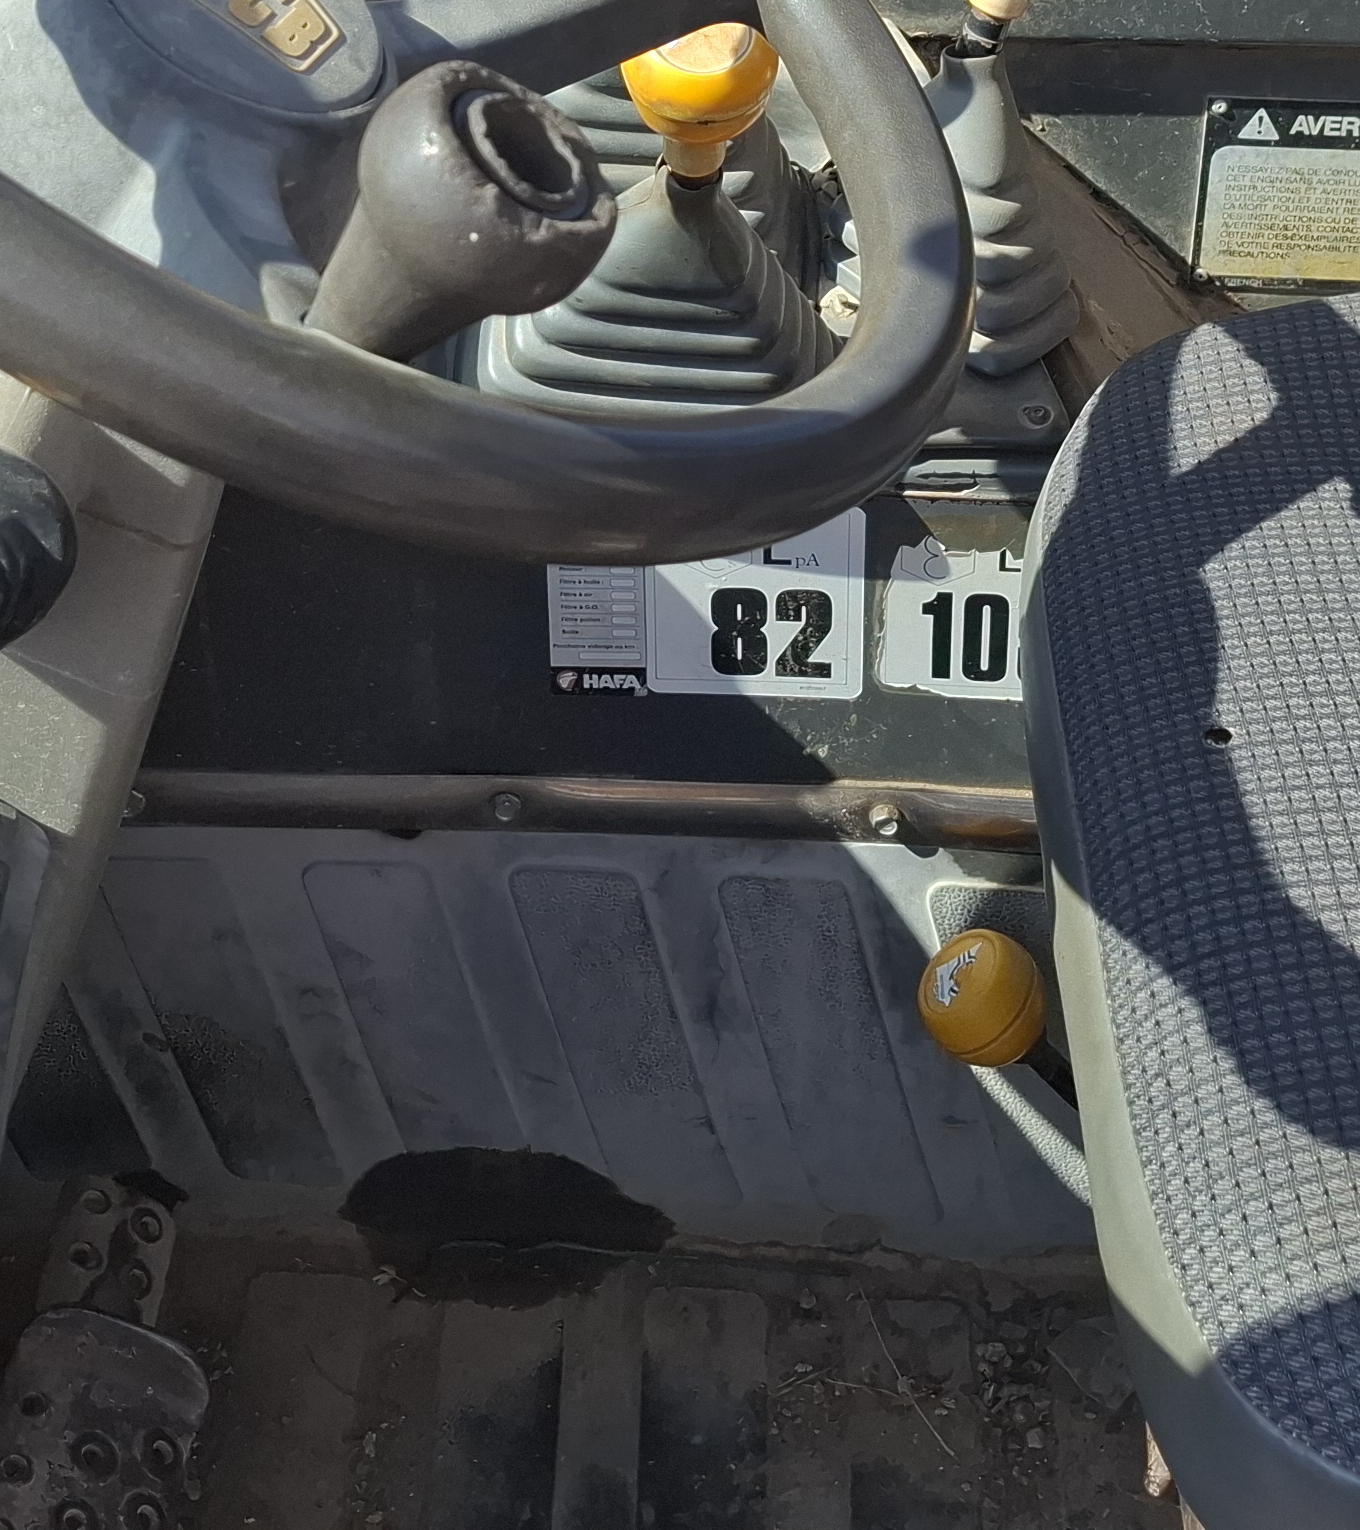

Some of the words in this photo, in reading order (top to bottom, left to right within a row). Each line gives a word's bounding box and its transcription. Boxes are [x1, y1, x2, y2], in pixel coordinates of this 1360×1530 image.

[1285, 166, 1305, 176] PAS
[1307, 167, 1321, 177] DE
[1226, 173, 1248, 183] CET
[1250, 174, 1283, 184] ENGIN
[1285, 176, 1314, 186] SANS
[1315, 177, 1345, 187] AVOIR
[1348, 178, 1360, 187] LU
[1224, 183, 1302, 195] INSTRUCTIONS
[1303, 186, 1318, 196] ET
[1298, 196, 1311, 205] ET
[1223, 203, 1236, 211] LA
[1238, 203, 1269, 212] MORT
[1272, 204, 1340, 215] POURRAIENT
[1221, 211, 1243, 221] DES
[1247, 212, 1324, 225] INSTRUCTIONS
[1325, 216, 1341, 225] OU
[1343, 216, 1358, 226] DE
[1219, 230, 1265, 240] OBTENIR
[1267, 232, 1288, 242] DES
[1235, 240, 1270, 250] VOTRE
[710, 587, 833, 679] 82
[921, 591, 1022, 683] 10
[582, 673, 641, 689] HAFA
